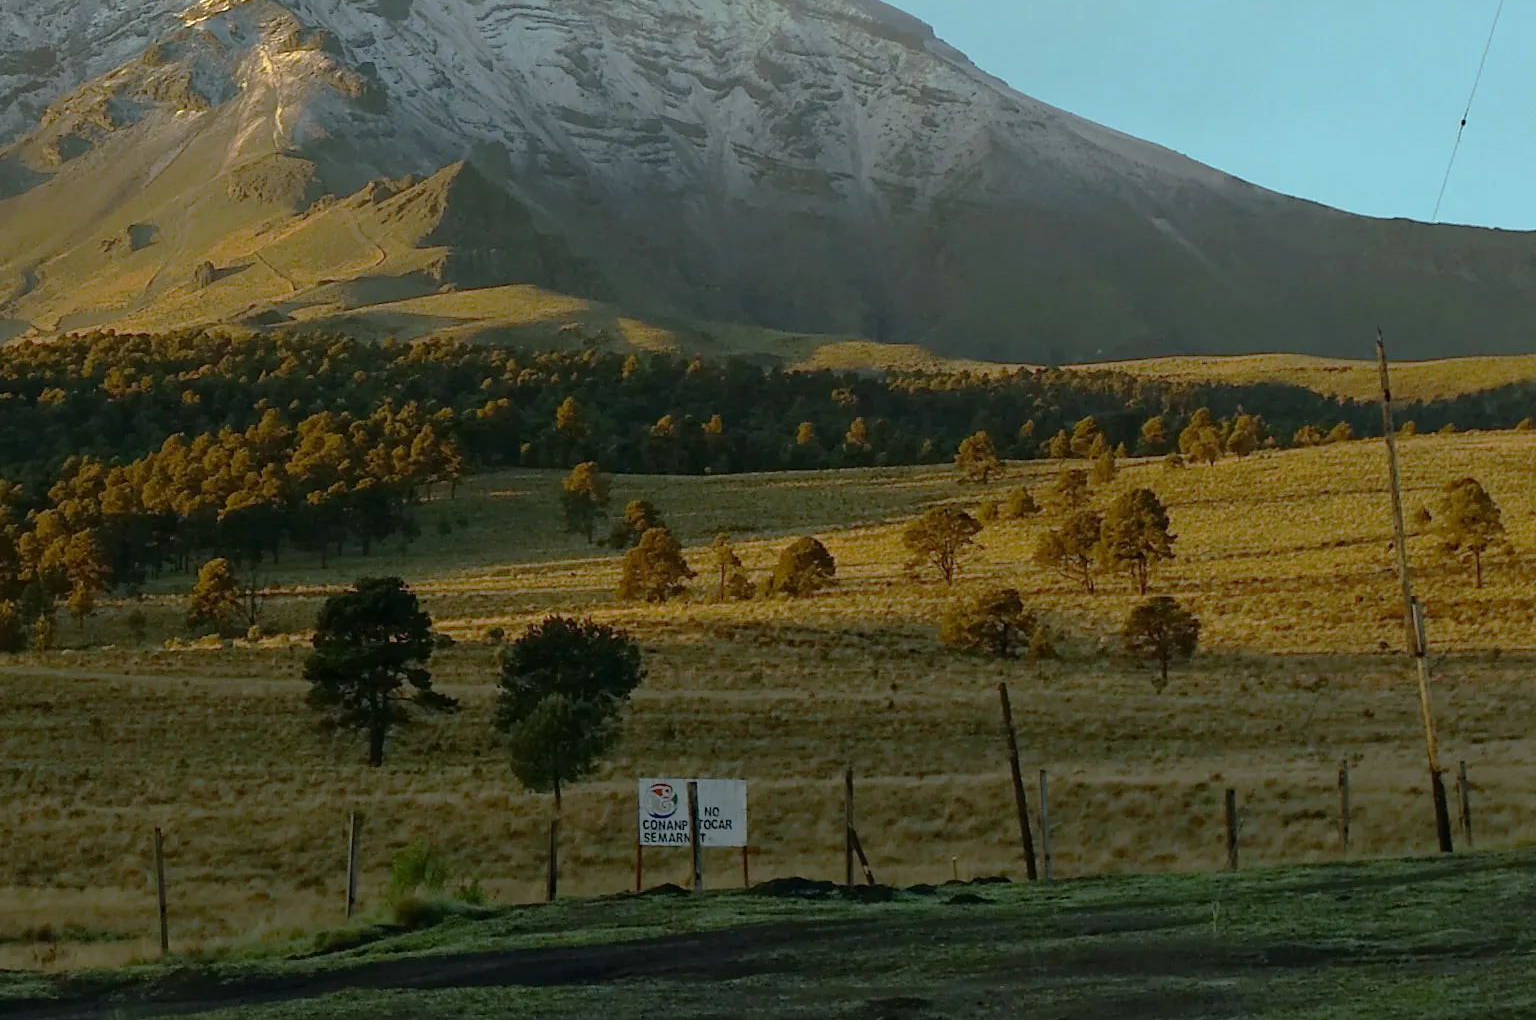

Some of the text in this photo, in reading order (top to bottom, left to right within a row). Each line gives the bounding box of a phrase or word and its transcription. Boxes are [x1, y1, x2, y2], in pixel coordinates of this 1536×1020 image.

[704, 806, 720, 817] NO
[643, 820, 688, 830] CONANP
[699, 819, 732, 829] TOCAR
[644, 833, 706, 843] SEMARNT
